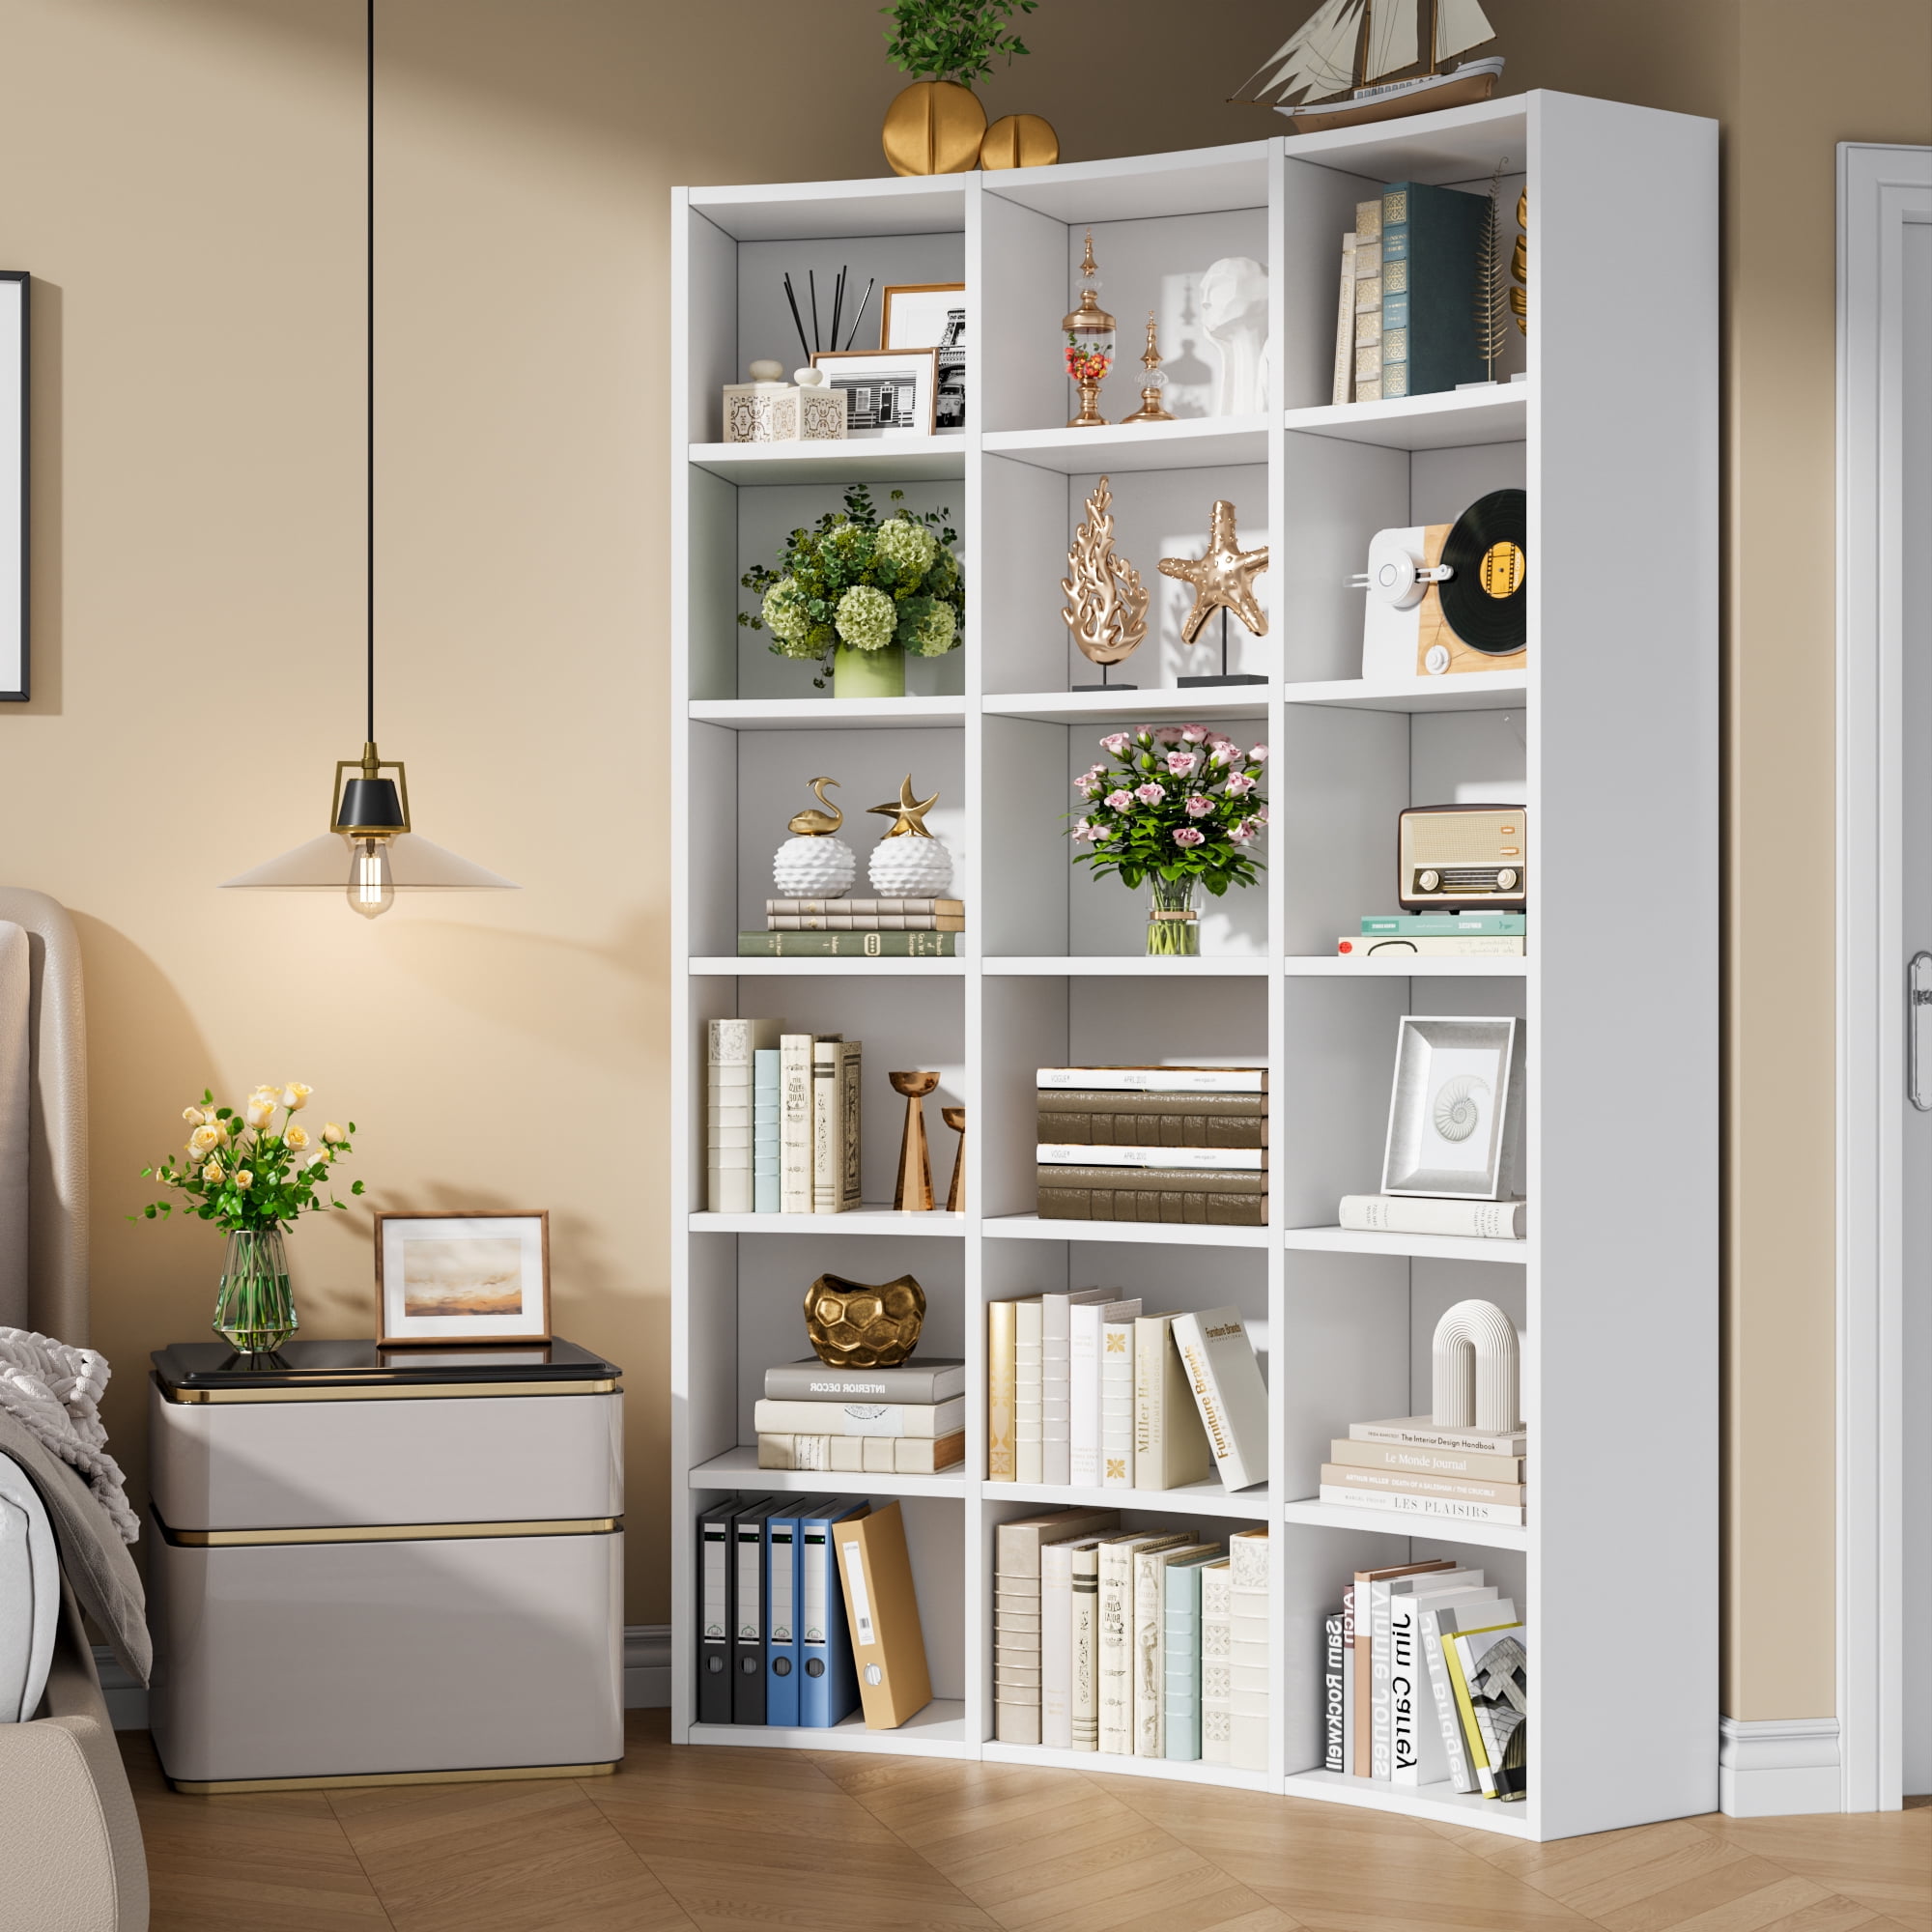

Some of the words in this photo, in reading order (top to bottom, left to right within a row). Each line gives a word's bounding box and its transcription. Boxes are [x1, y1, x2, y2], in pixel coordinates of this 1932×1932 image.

[1184, 1345, 1208, 1395] Brands
[1138, 1403, 1150, 1454] Miller
[1201, 1396, 1229, 1460] Furniture
[1402, 1433, 1413, 1441] The
[1413, 1435, 1436, 1445] Interior
[1437, 1436, 1461, 1448] Design
[1462, 1439, 1495, 1450] Handbook
[1385, 1452, 1397, 1463] Le
[1398, 1453, 1430, 1467] Monde
[1432, 1457, 1467, 1471] Journal
[1346, 1473, 1368, 1483] ARTHUR
[1369, 1476, 1389, 1485] MILLER
[1391, 1478, 1409, 1487] DEATH
[1423, 1482, 1452, 1492] SALESMAN
[1457, 1486, 1467, 1494] THE
[1467, 1488, 1496, 1497] CRUCIBLE
[1395, 1496, 1418, 1510] LES
[1425, 1500, 1489, 1518] PLAISIRS
